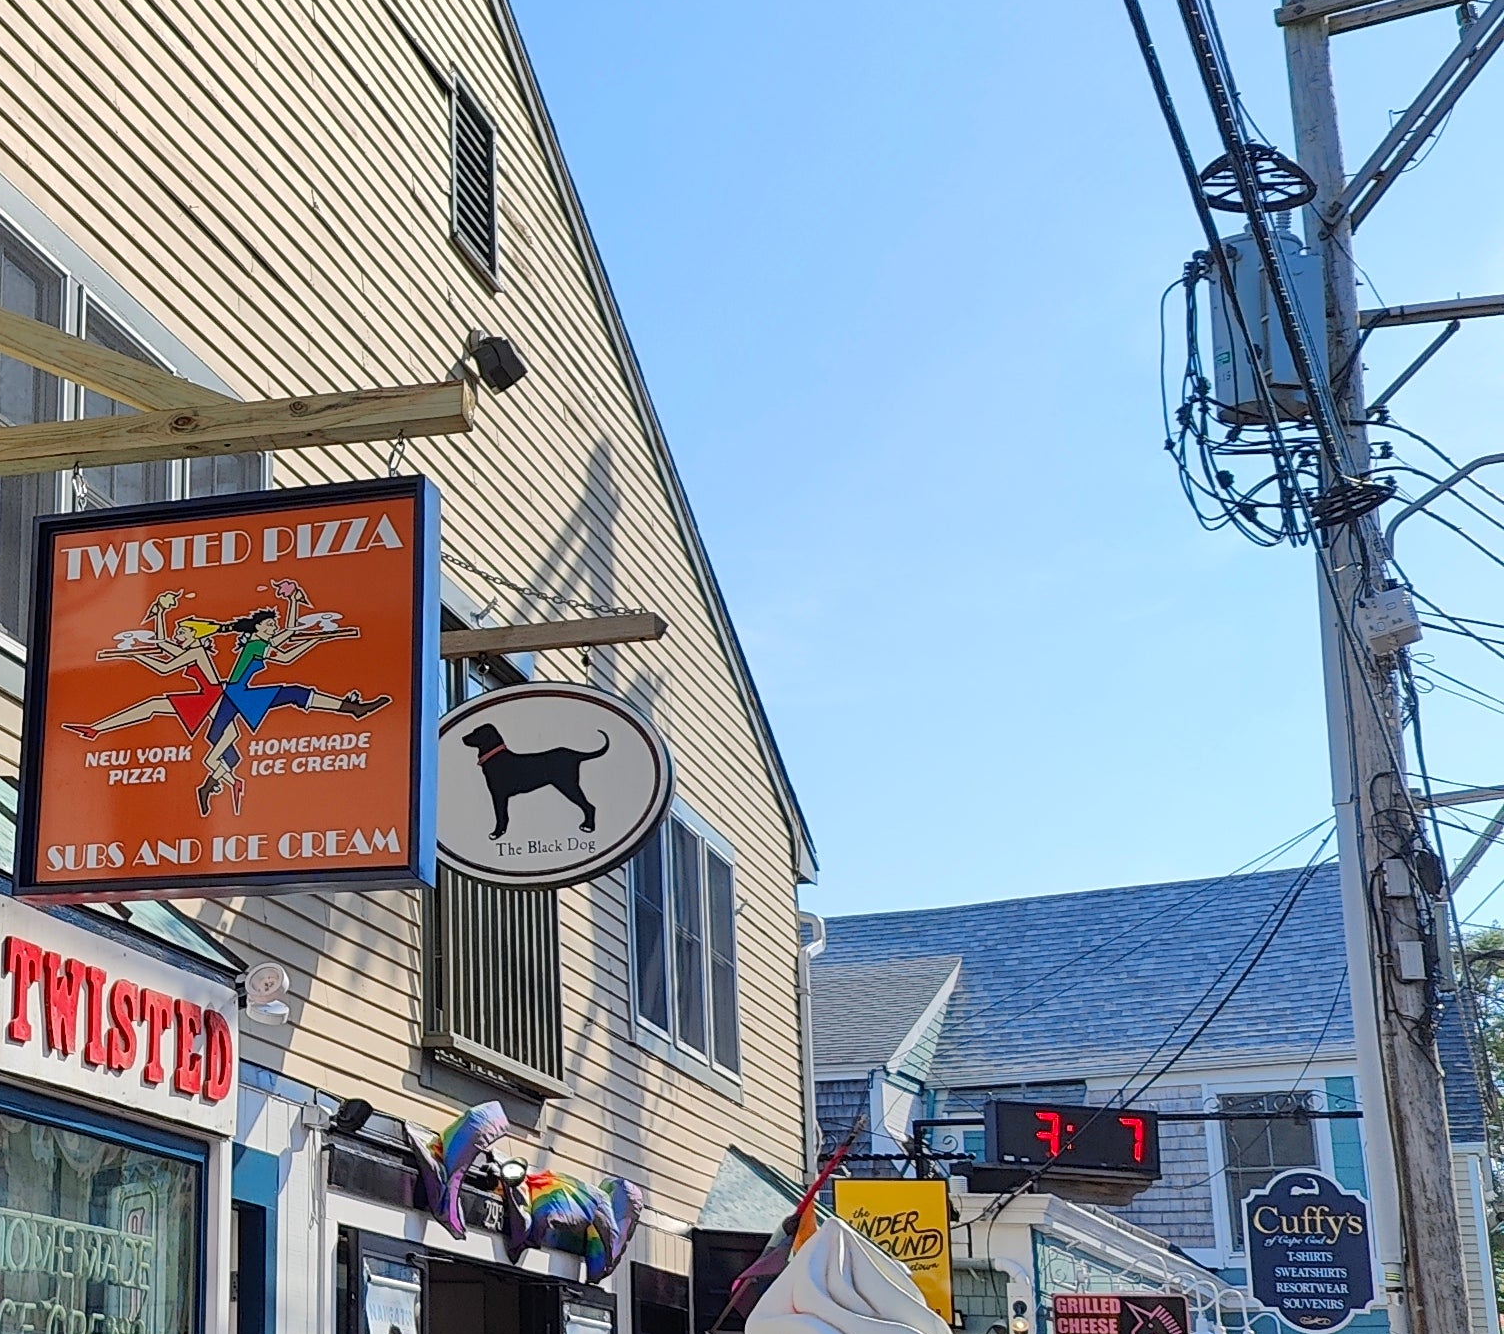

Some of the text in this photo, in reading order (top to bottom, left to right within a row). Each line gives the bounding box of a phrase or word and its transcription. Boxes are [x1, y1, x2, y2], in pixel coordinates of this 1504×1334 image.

[60, 513, 404, 582] TWISTED PIZZA
[248, 732, 371, 755] HOMEMADE
[85, 745, 193, 768] NEW YORK
[250, 752, 367, 775] ICE CREAM
[108, 766, 167, 785] PIZZA
[45, 827, 401, 872] SUBS AND ICE CREAM
[496, 837, 596, 857] The Black Dog
[2, 935, 233, 1102] TWISTED
[852, 1207, 871, 1219] the
[1252, 1205, 1364, 1245] Cuffy's
[1264, 1234, 1327, 1248] of Cape Cod
[1286, 1251, 1334, 1262] T-SHIRTS
[1274, 1267, 1348, 1278] SWEATSHIRTS
[1276, 1282, 1350, 1294] RESORTWEAR
[1056, 1297, 1121, 1315] GRILLED
[1282, 1298, 1345, 1310] SOUVENIRS
[1057, 1318, 1119, 1334] CHEESE
